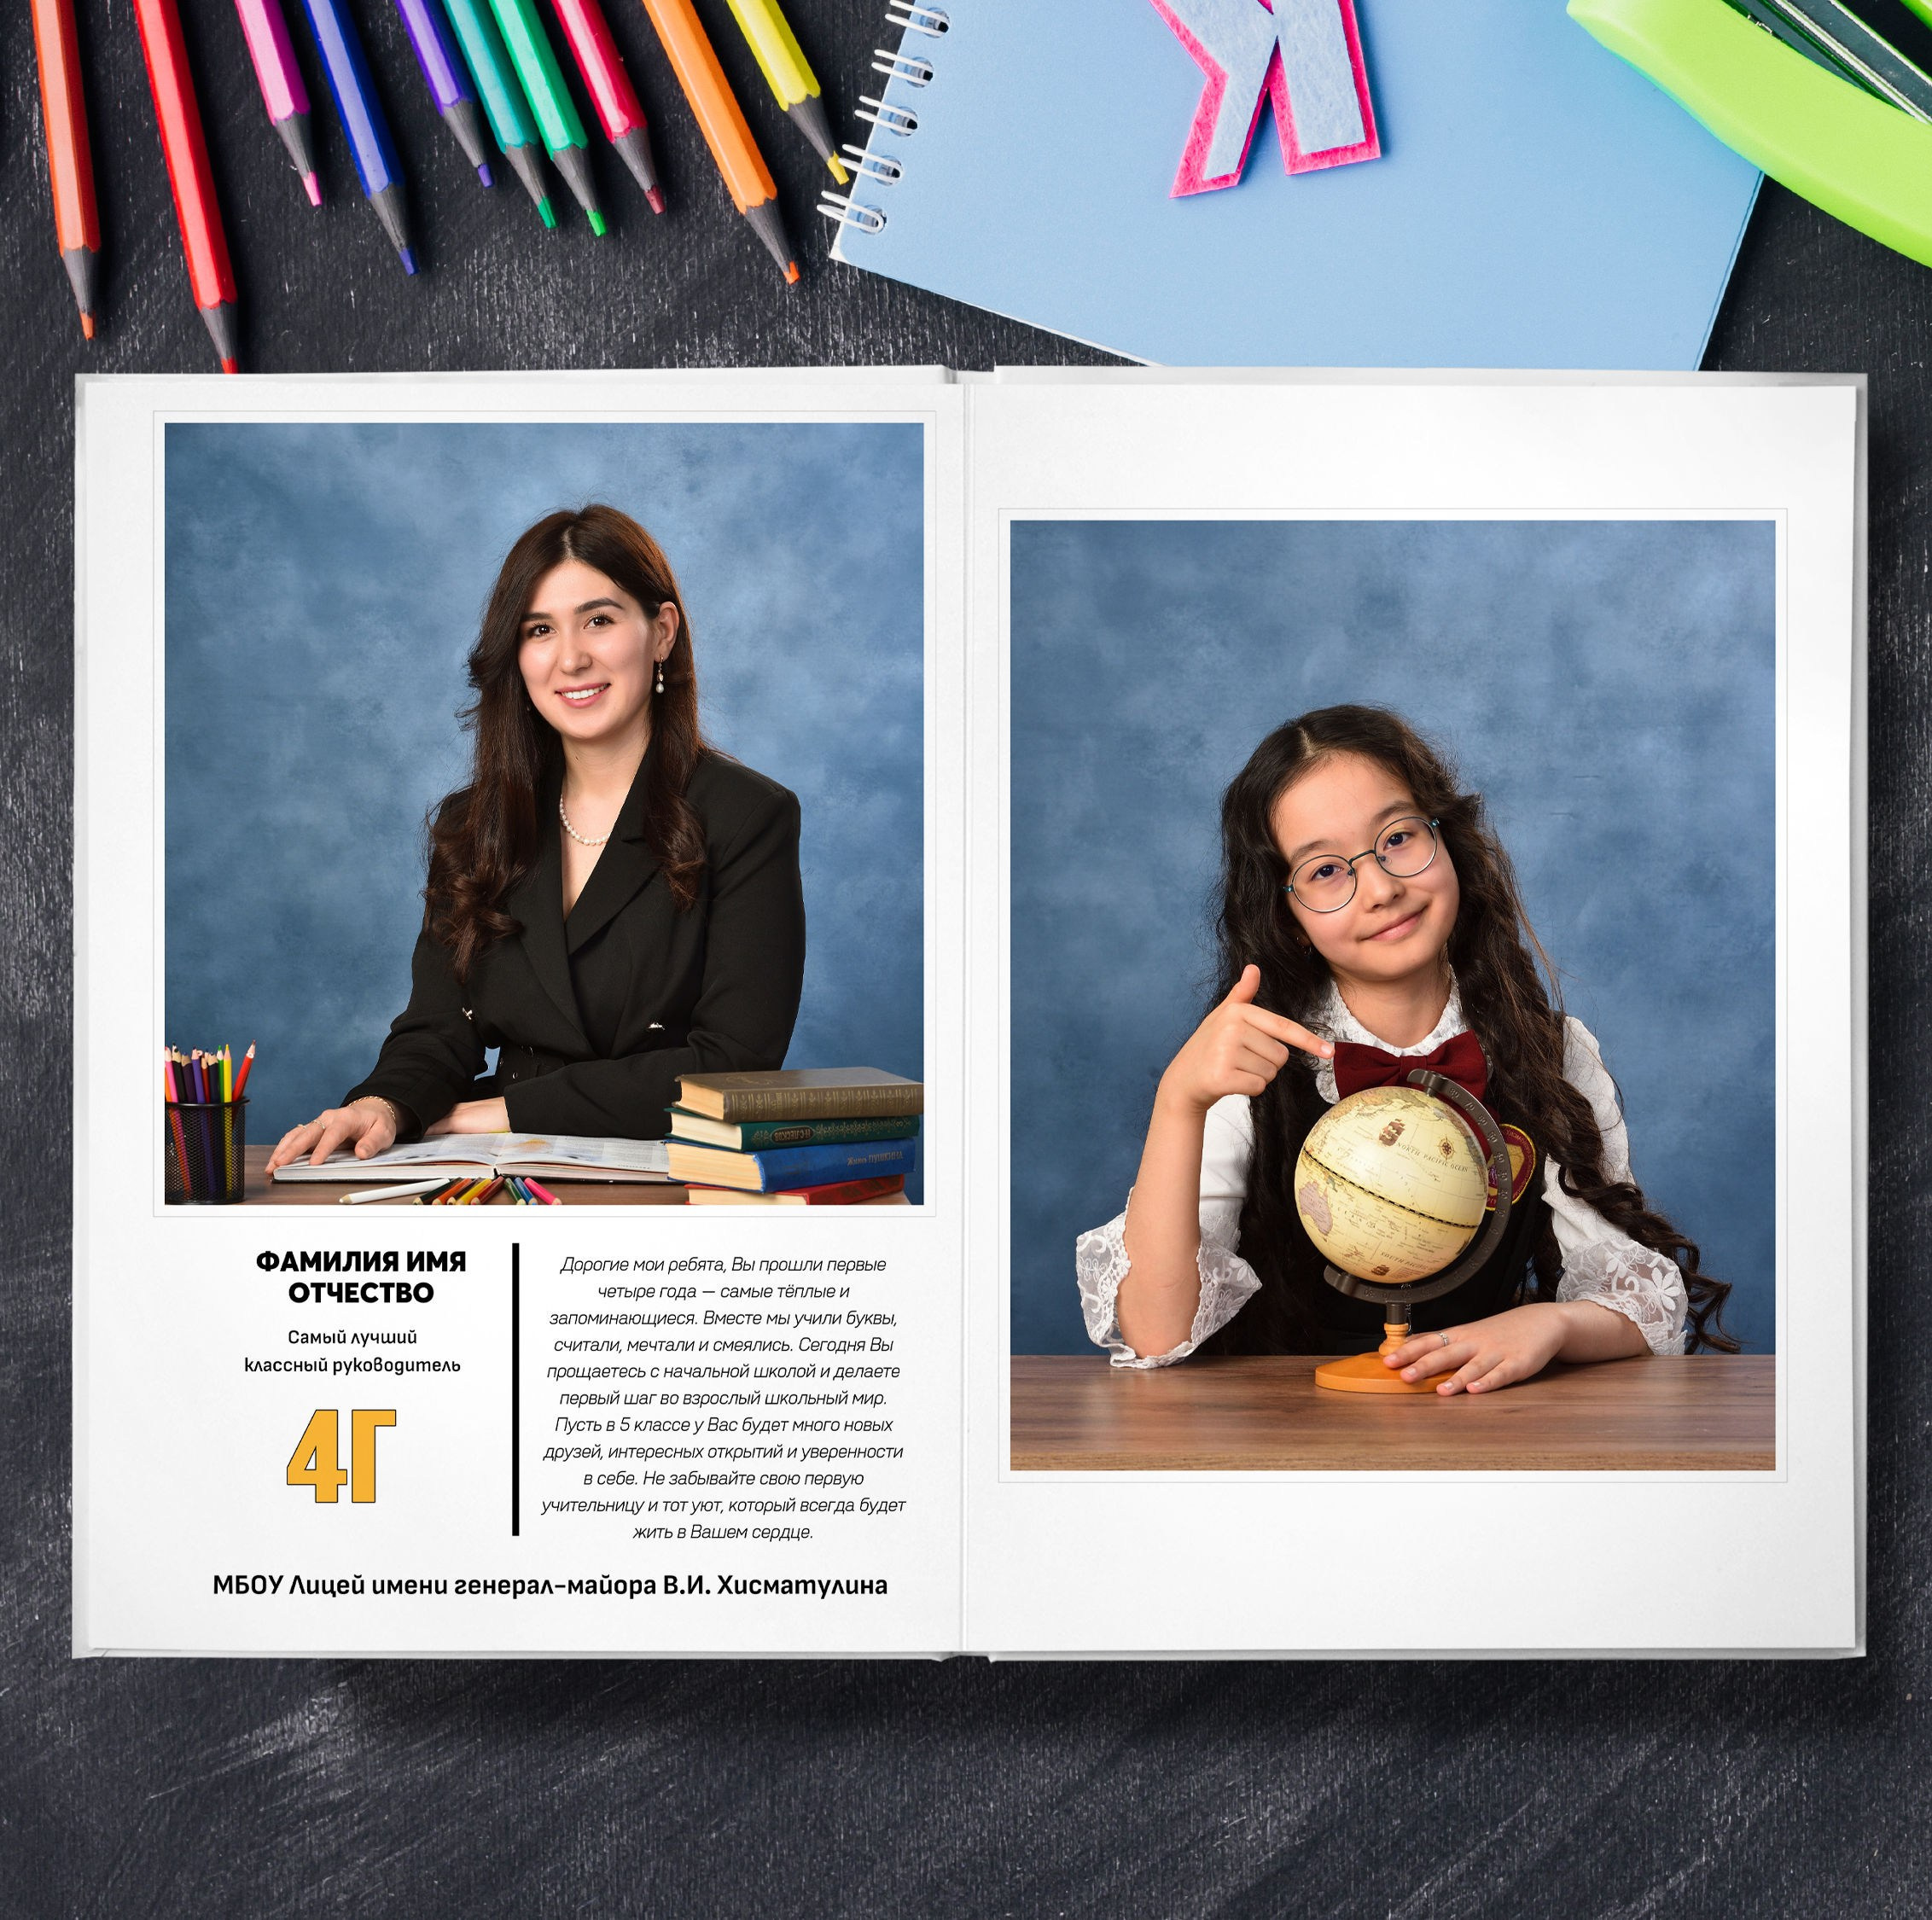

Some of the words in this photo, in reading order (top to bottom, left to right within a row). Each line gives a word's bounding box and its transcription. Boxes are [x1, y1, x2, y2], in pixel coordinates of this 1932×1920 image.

[1395, 1141, 1421, 1156] NORTH
[1423, 1153, 1449, 1167] PACIFIC
[256, 1250, 399, 1272] ФАМИЛИЯ
[406, 1250, 467, 1272] ИМЯ
[559, 1256, 630, 1276] Дорогие
[632, 1260, 665, 1271] мои
[667, 1256, 727, 1276] ребята,
[731, 1256, 756, 1271] Вы
[759, 1260, 823, 1275] прошли
[826, 1260, 887, 1275] первые
[1380, 1251, 1405, 1264] SOUTH
[288, 1282, 434, 1304] ОТЧЕСТВО
[598, 1287, 655, 1302] четыре
[659, 1287, 697, 1301] года
[720, 1287, 773, 1299] самые
[777, 1283, 836, 1299] тёплые
[839, 1287, 851, 1298] и
[549, 1313, 698, 1328] запоминающиеся.
[703, 1310, 763, 1325] Вместе
[765, 1313, 791, 1325] мы
[792, 1313, 842, 1329] учили
[846, 1310, 897, 1329] буквы,
[288, 1329, 346, 1345] Самый
[350, 1329, 417, 1348] лучший
[554, 1340, 622, 1354] считали,
[626, 1340, 695, 1352] мечтали
[698, 1341, 710, 1352] и
[713, 1340, 793, 1352] смеялись.
[798, 1336, 866, 1355] Сегодня
[870, 1336, 894, 1352] Вы
[244, 1357, 328, 1372] классный
[333, 1356, 461, 1376] руководитель
[546, 1366, 647, 1382] прощаетесь
[649, 1366, 660, 1378] с
[663, 1363, 750, 1378] начальной
[754, 1363, 817, 1378] школой
[819, 1366, 831, 1378] и
[832, 1366, 900, 1382] делаете
[559, 1389, 620, 1409] первый
[624, 1393, 658, 1405] шаг
[660, 1393, 679, 1405] во
[683, 1389, 761, 1409] взрослый
[765, 1389, 849, 1405] школьный
[852, 1393, 887, 1409] мир.
[555, 1417, 602, 1435] Пусть
[606, 1420, 615, 1432] в
[620, 1417, 631, 1432] 5
[633, 1420, 690, 1432] классе
[692, 1420, 705, 1435] у
[707, 1417, 738, 1432] Вас
[742, 1417, 789, 1435] будет
[792, 1420, 841, 1432] много
[843, 1420, 894, 1432] новых
[286, 1409, 397, 1504] 4Г
[542, 1443, 603, 1463] друзей,
[608, 1446, 705, 1463] интересных
[707, 1443, 783, 1463] открытий
[786, 1446, 798, 1458] и
[800, 1446, 904, 1463] уверенности
[583, 1474, 593, 1486] в
[596, 1470, 638, 1486] себе.
[643, 1470, 666, 1486] Не
[668, 1470, 756, 1486] забывайте
[759, 1474, 801, 1486] свою
[804, 1474, 864, 1489] первую
[540, 1500, 645, 1516] учительницу
[648, 1500, 659, 1512] и
[662, 1500, 690, 1512] тот
[690, 1500, 724, 1516] уют,
[728, 1497, 796, 1516] который
[800, 1500, 855, 1516] всегда
[859, 1497, 907, 1516] будет
[632, 1527, 673, 1539] жить
[677, 1527, 687, 1539] в
[690, 1523, 748, 1539] Вашем
[752, 1527, 813, 1543] сердце.
[213, 1574, 284, 1595] МБОУ
[288, 1574, 365, 1598] Лицей
[372, 1579, 448, 1595] имени
[454, 1574, 656, 1600] генерал-майора
[663, 1574, 711, 1595] В.И.
[717, 1574, 887, 1600] Хисматулина
